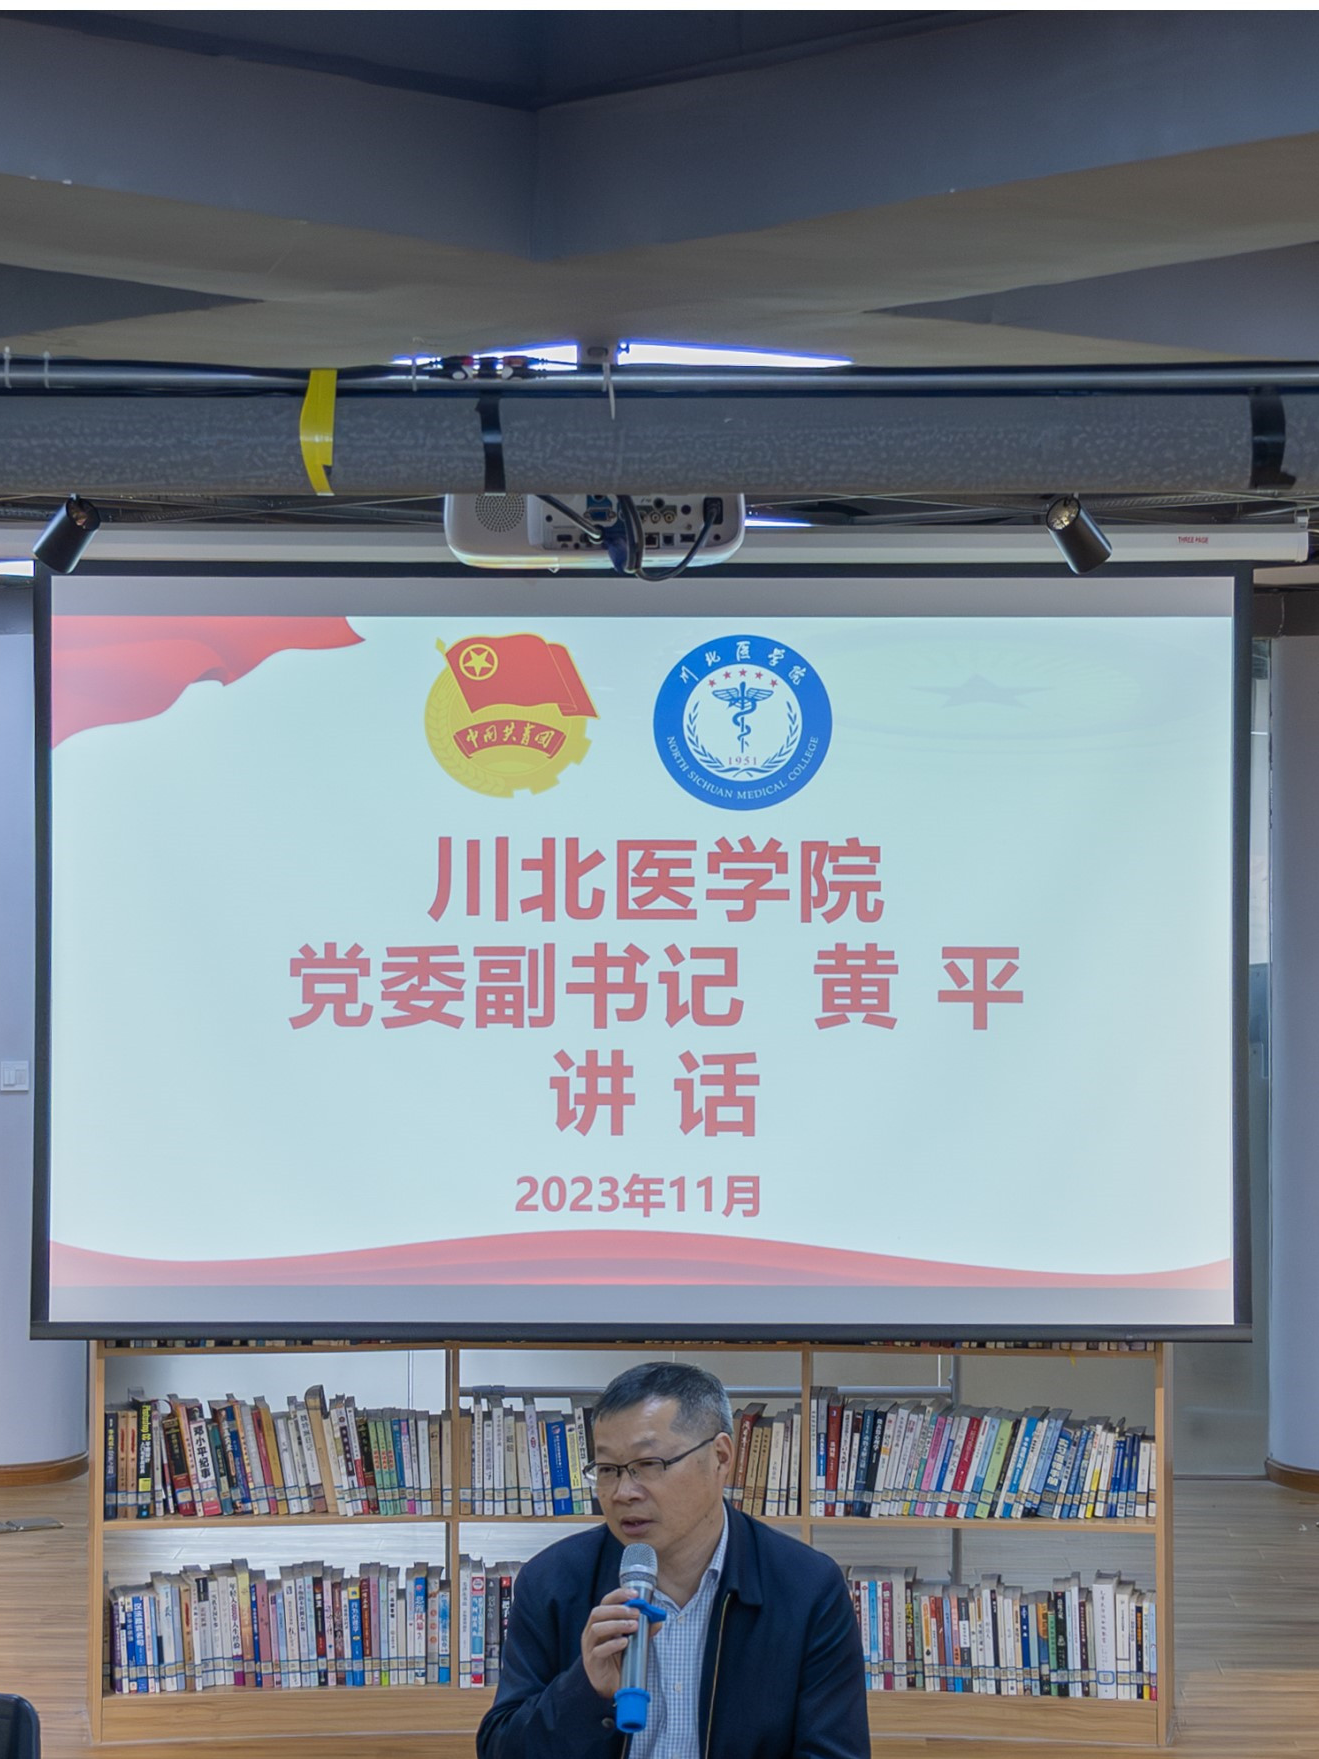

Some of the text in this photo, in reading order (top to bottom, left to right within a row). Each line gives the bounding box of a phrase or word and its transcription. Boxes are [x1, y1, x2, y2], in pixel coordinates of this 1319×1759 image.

[680, 640, 807, 686] 川北医学院
[666, 735, 820, 801] NORTH SICHUAN MEDICAL COLLEGE
[727, 755, 758, 767] 1951
[430, 837, 884, 923] 川北医学院
[292, 943, 1022, 1029] 党委副书记 黄 平
[551, 1051, 759, 1136] 讲 话
[516, 1175, 760, 1217] 2023年11月
[193, 1425, 212, 1479] 邓小平纪事
